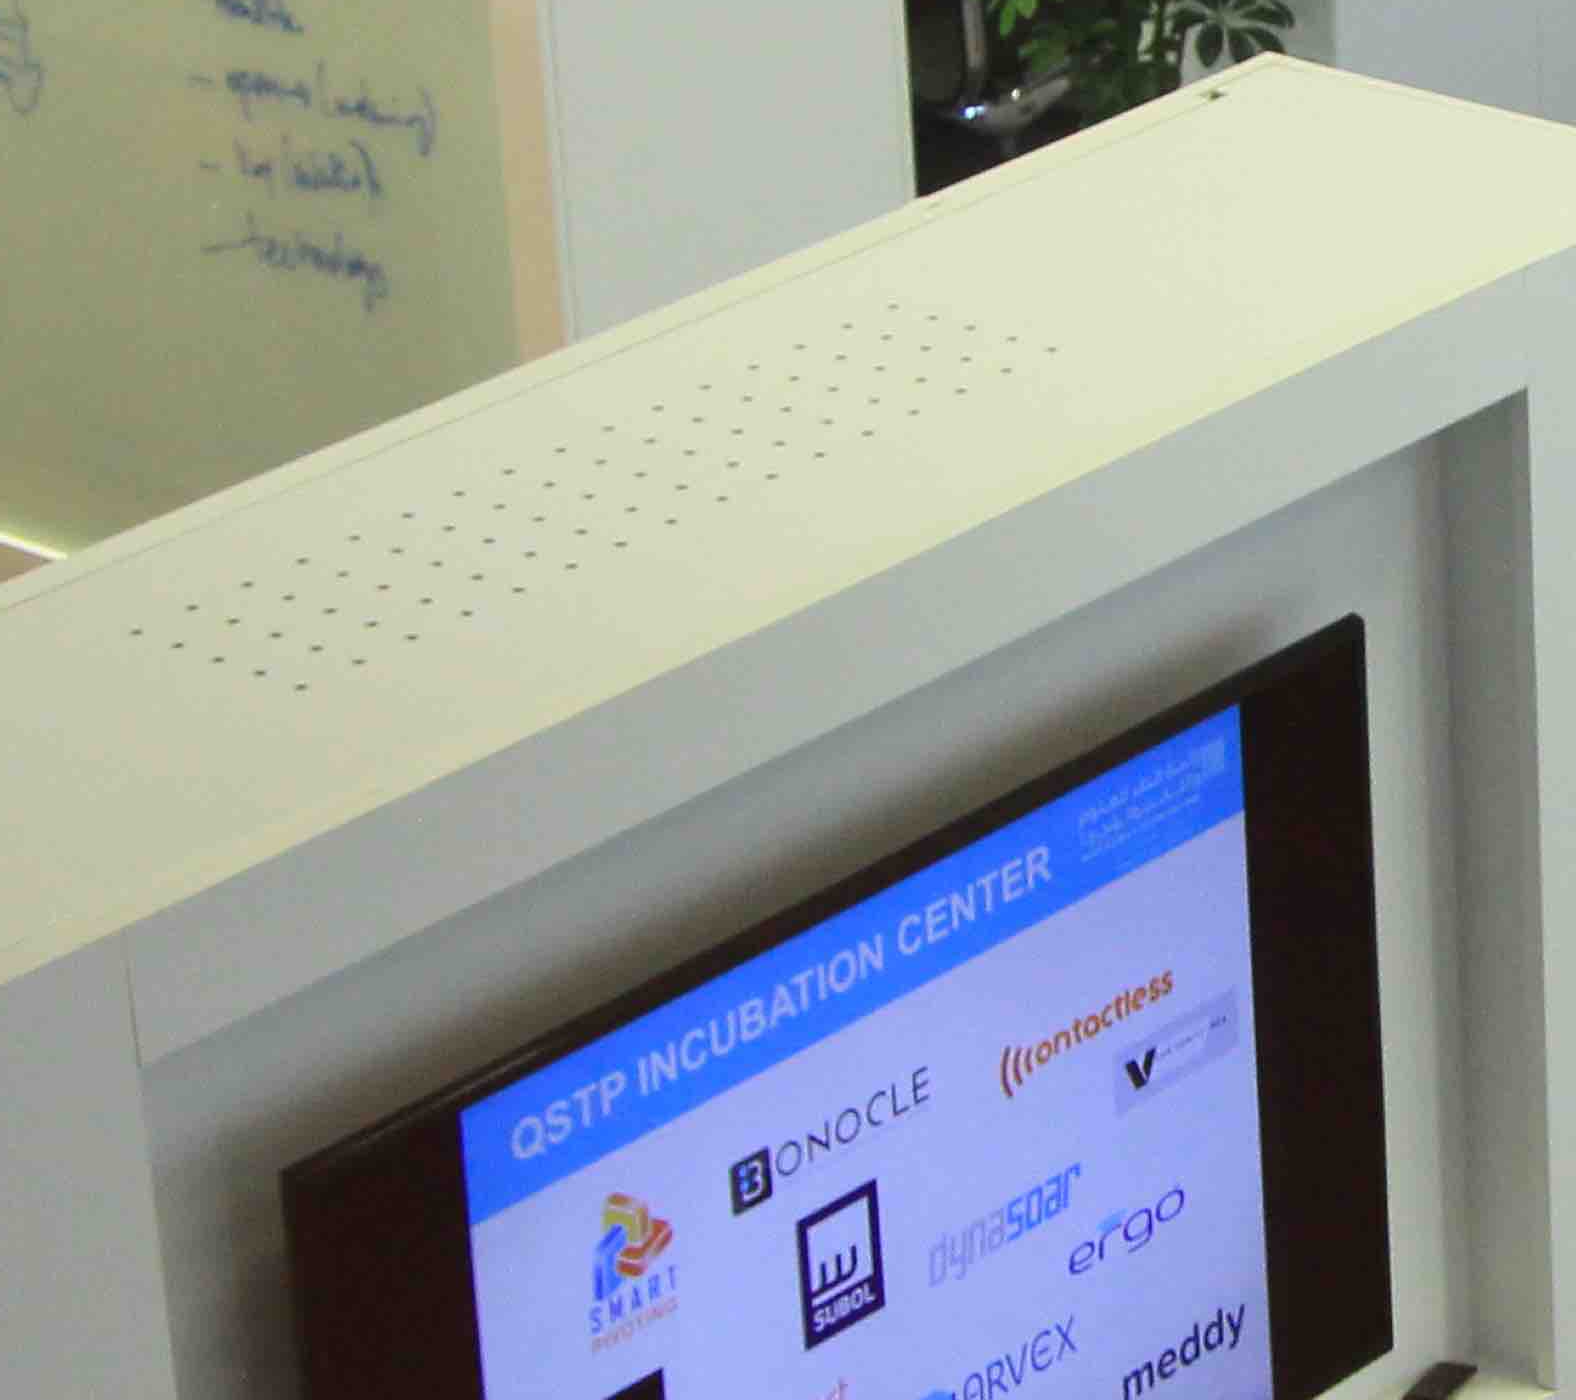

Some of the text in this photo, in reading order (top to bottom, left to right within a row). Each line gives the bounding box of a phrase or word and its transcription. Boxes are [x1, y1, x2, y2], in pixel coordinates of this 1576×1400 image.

[510, 845, 1054, 1160] QSTP INCUBATION CENTER
[928, 1161, 1082, 1289] dynasoar
[1068, 1184, 1186, 1276] ergo
[589, 1264, 678, 1335] SMART
[812, 1281, 877, 1334] SUBOL
